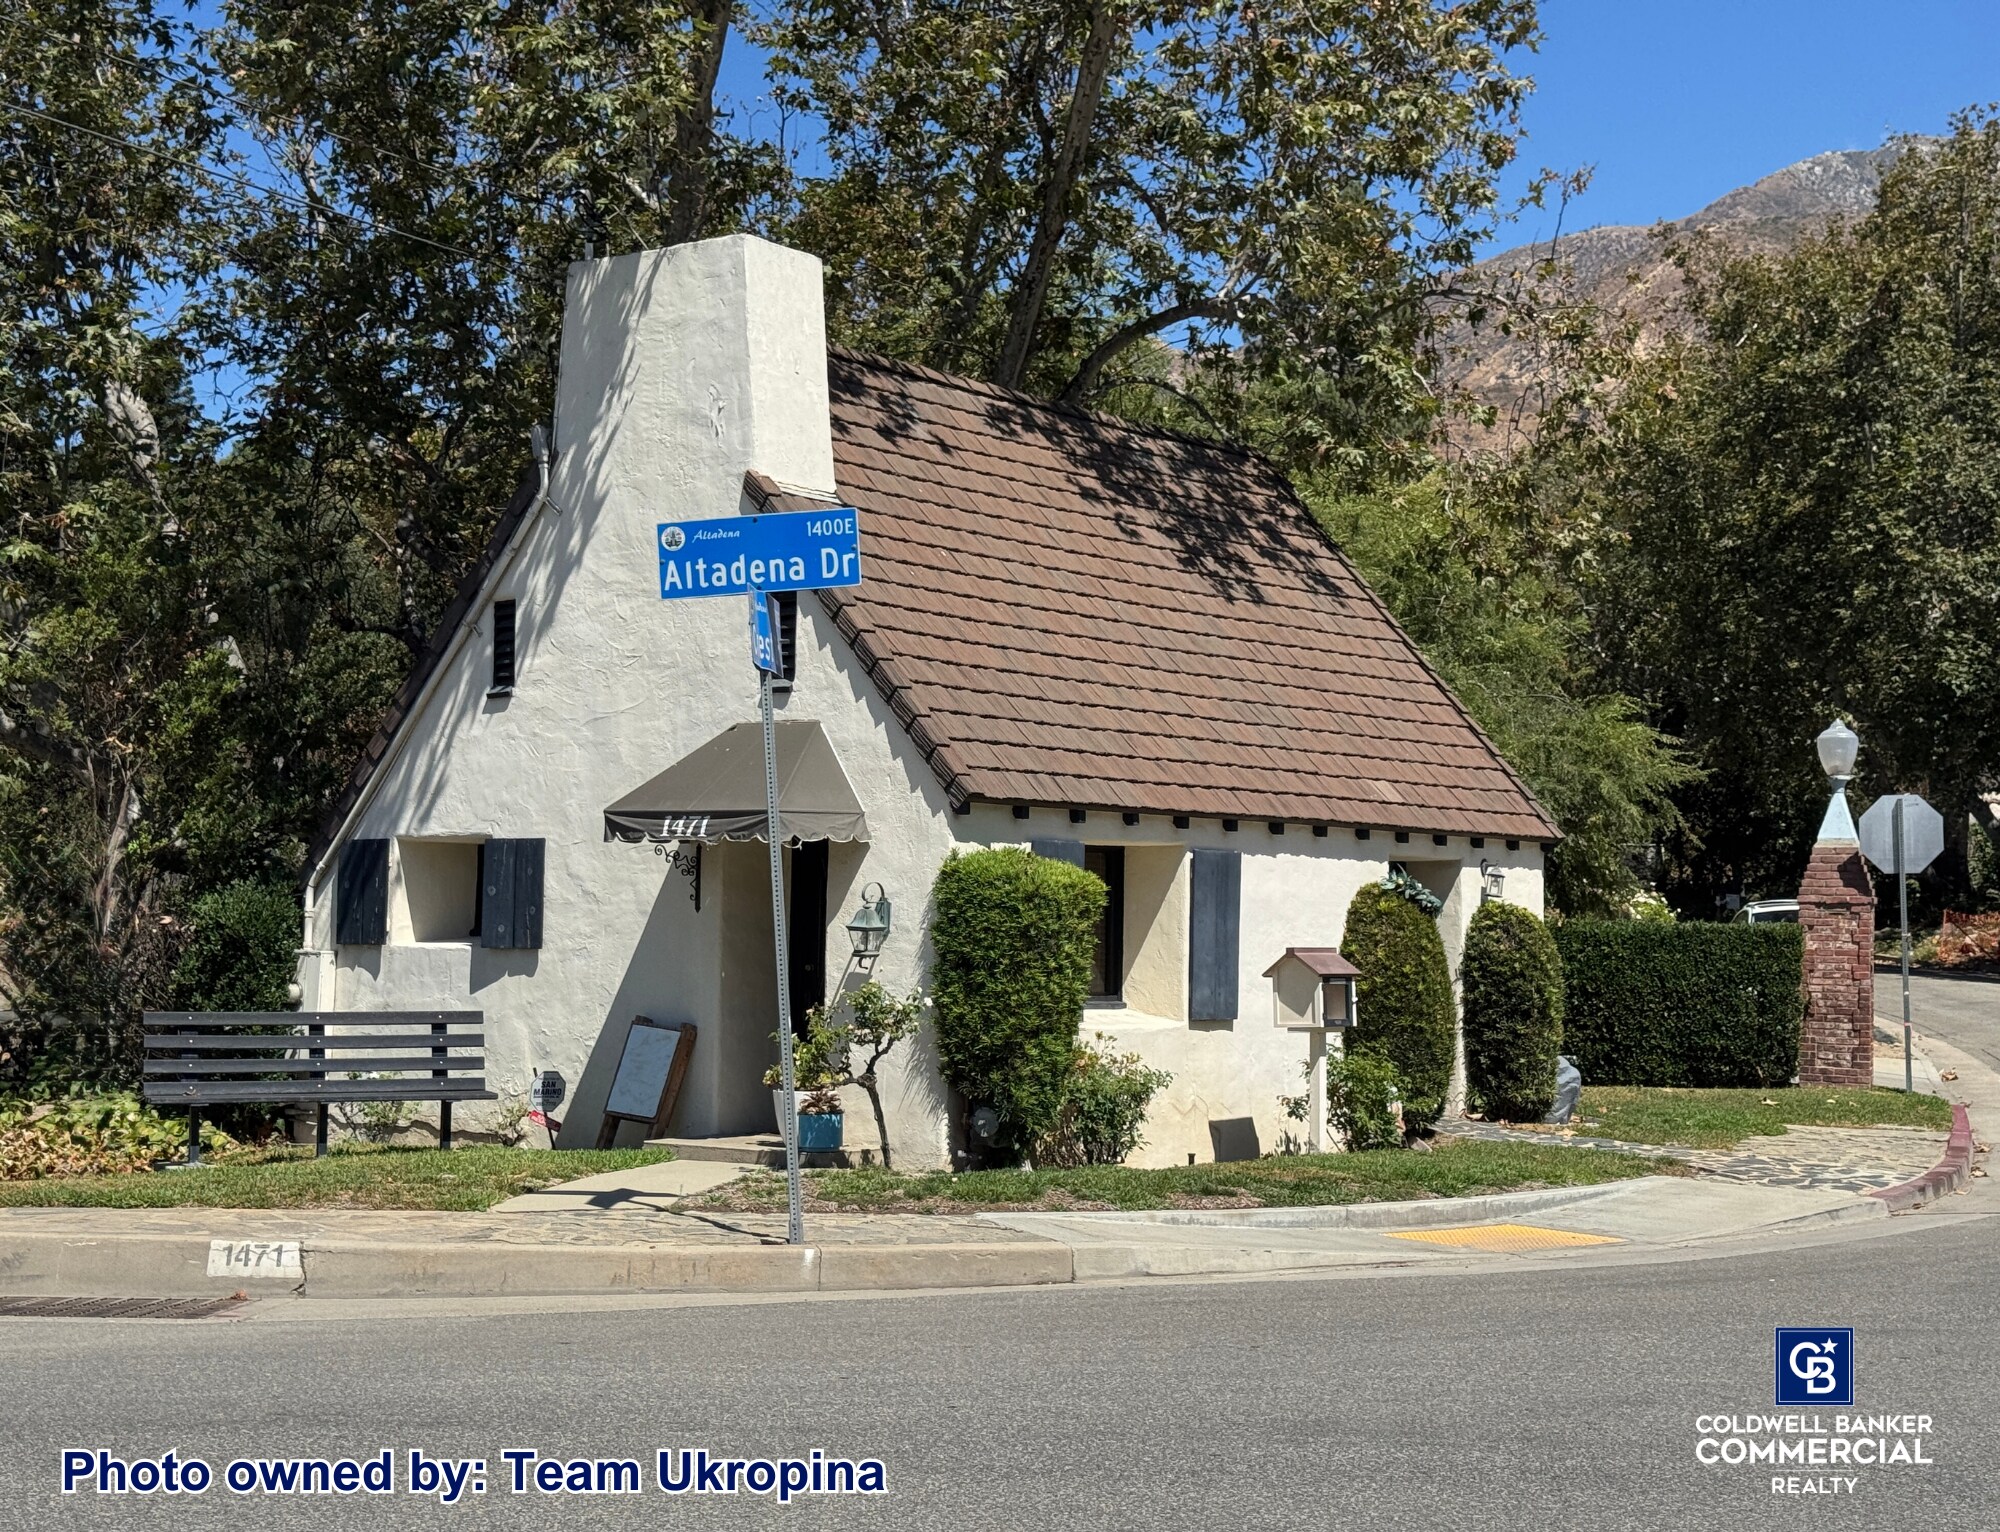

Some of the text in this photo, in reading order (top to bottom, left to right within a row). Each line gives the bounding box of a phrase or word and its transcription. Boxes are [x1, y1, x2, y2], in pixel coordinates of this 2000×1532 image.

[691, 528, 740, 543] Altadena
[806, 518, 854, 537] 1400E
[664, 547, 856, 591] Altadena Dr
[660, 815, 711, 837] 1471
[533, 1087, 562, 1096] MARINO
[541, 1080, 557, 1088] SAN
[222, 1243, 284, 1268] 1471
